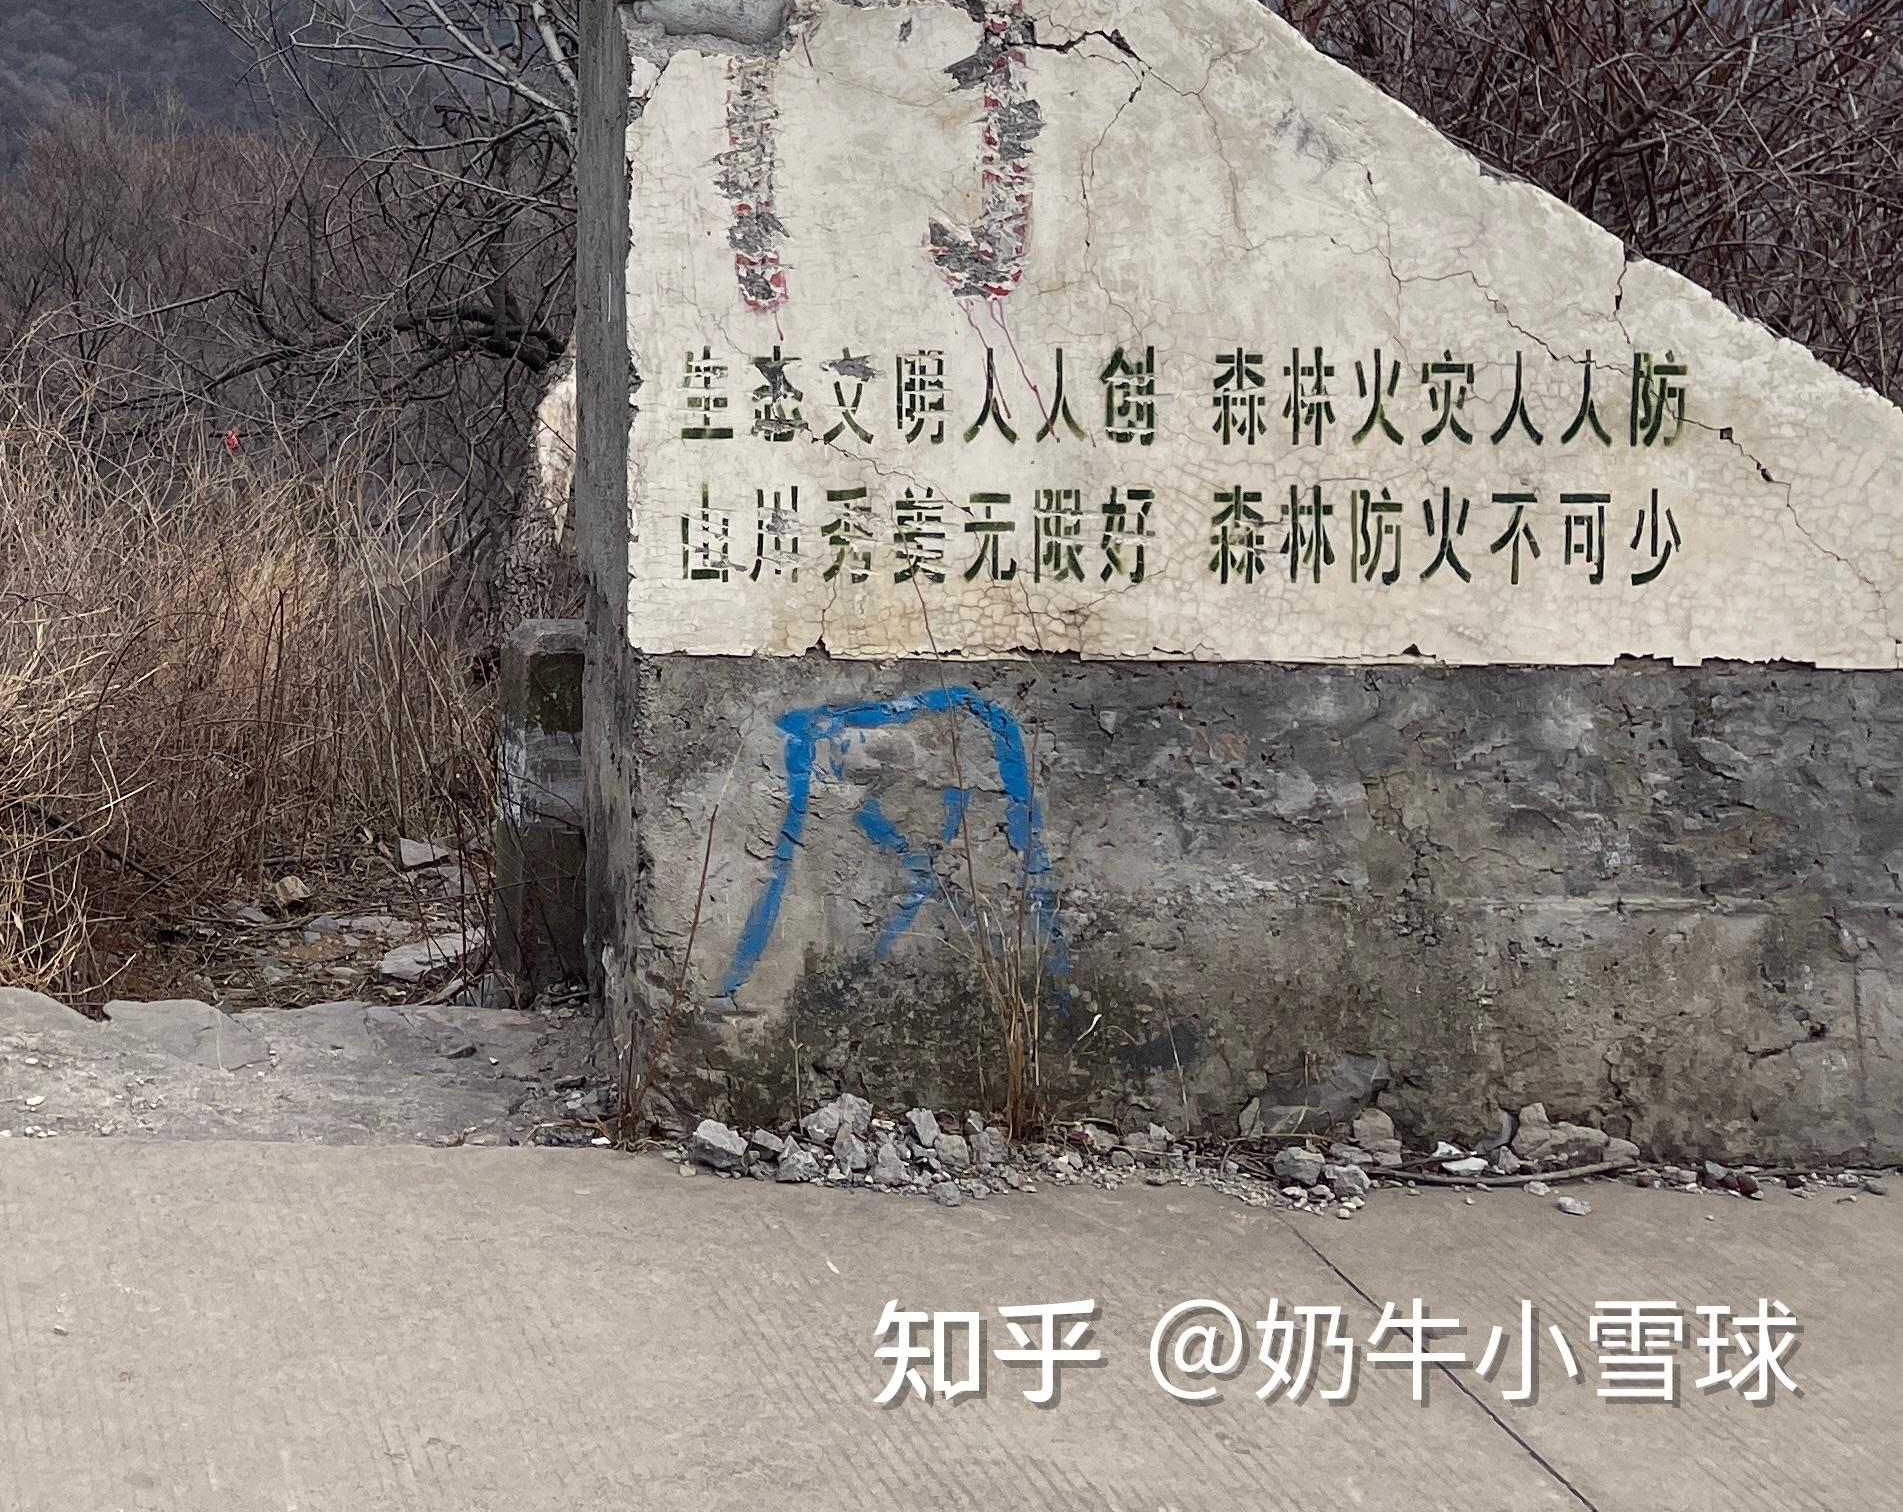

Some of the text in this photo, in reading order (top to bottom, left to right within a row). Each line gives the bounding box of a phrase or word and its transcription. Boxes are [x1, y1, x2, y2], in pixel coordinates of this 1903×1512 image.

[681, 345, 1689, 448] 生态文明人人创 森林火灾人人防
[681, 485, 1682, 586] 山川秀美无限好 森林防火不可少
